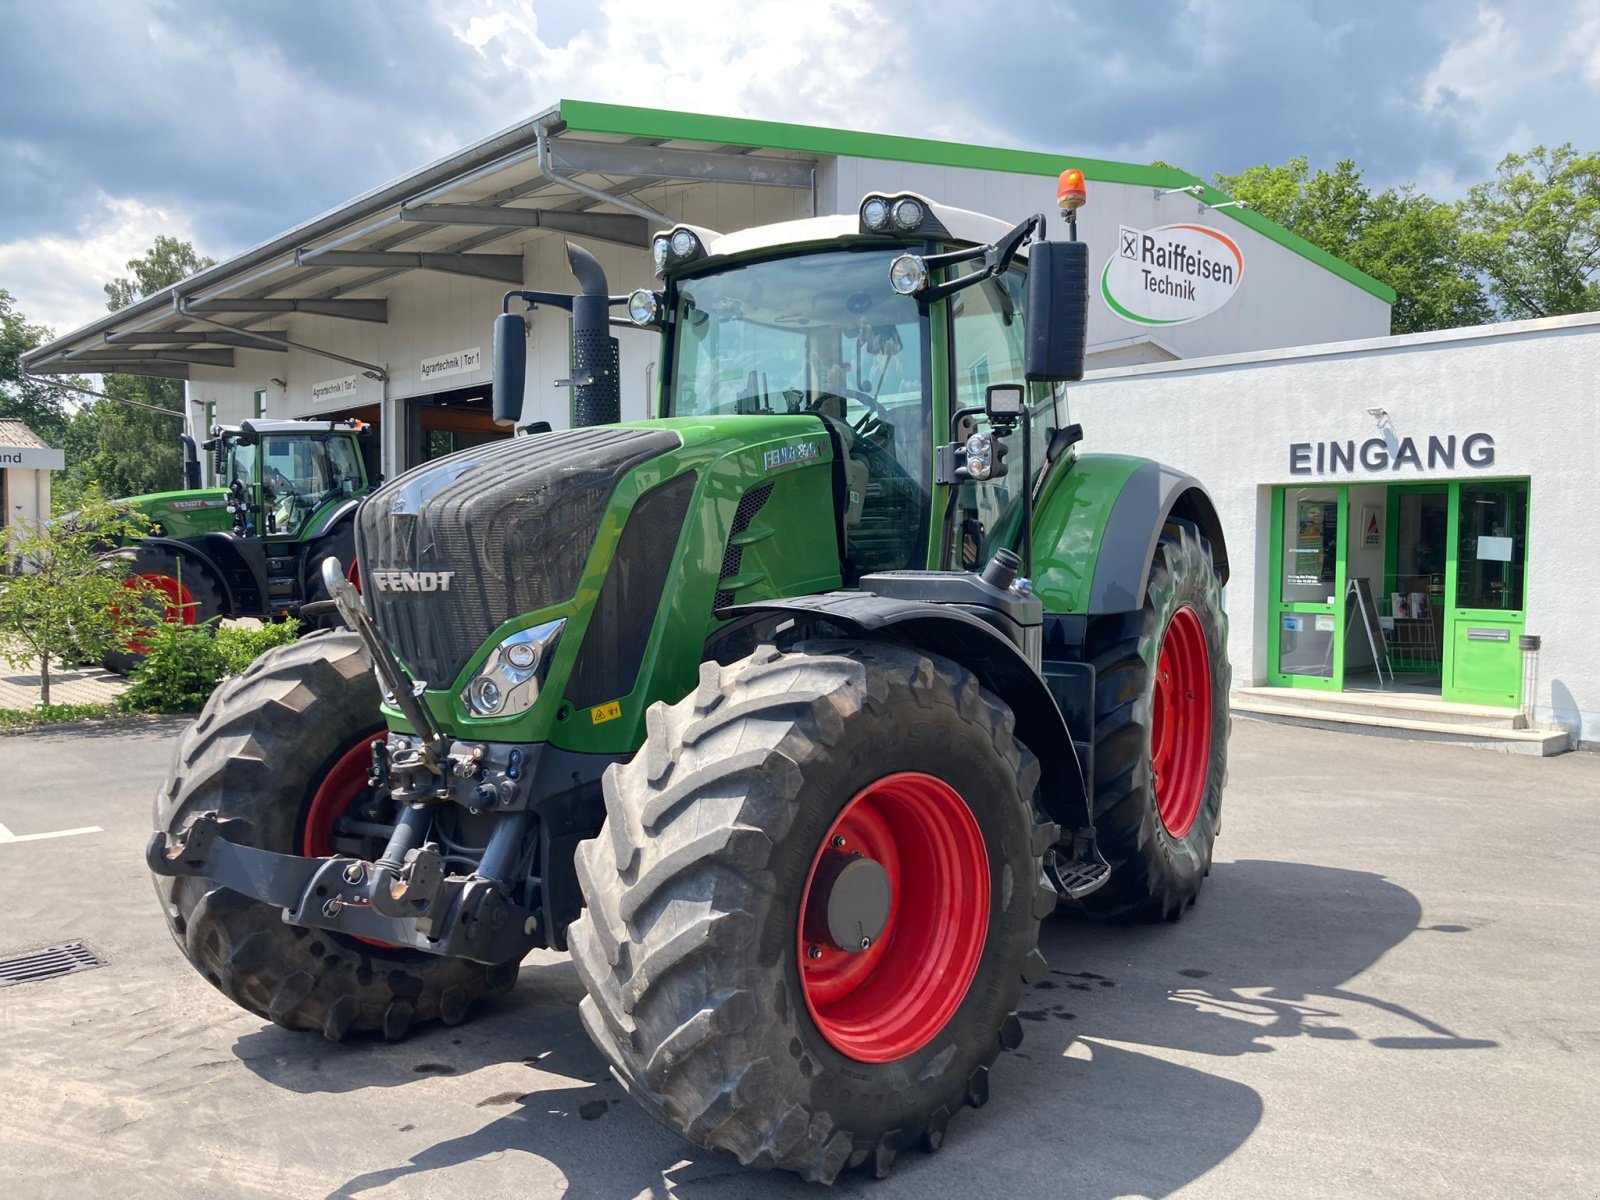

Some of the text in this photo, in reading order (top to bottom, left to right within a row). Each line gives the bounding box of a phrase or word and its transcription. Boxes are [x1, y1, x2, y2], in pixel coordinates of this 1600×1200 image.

[1142, 234, 1233, 285] Raiffeisen
[1141, 269, 1196, 301] Technik
[421, 357, 459, 376] Agrartechnik
[464, 354, 474, 366] Tor
[475, 352, 480, 363] 1
[313, 383, 341, 398] Agrartechnik
[344, 380, 352, 391] Tor
[0, 452, 22, 463] nd
[1289, 432, 1495, 475] EINGANG
[372, 571, 456, 592] FENDT
